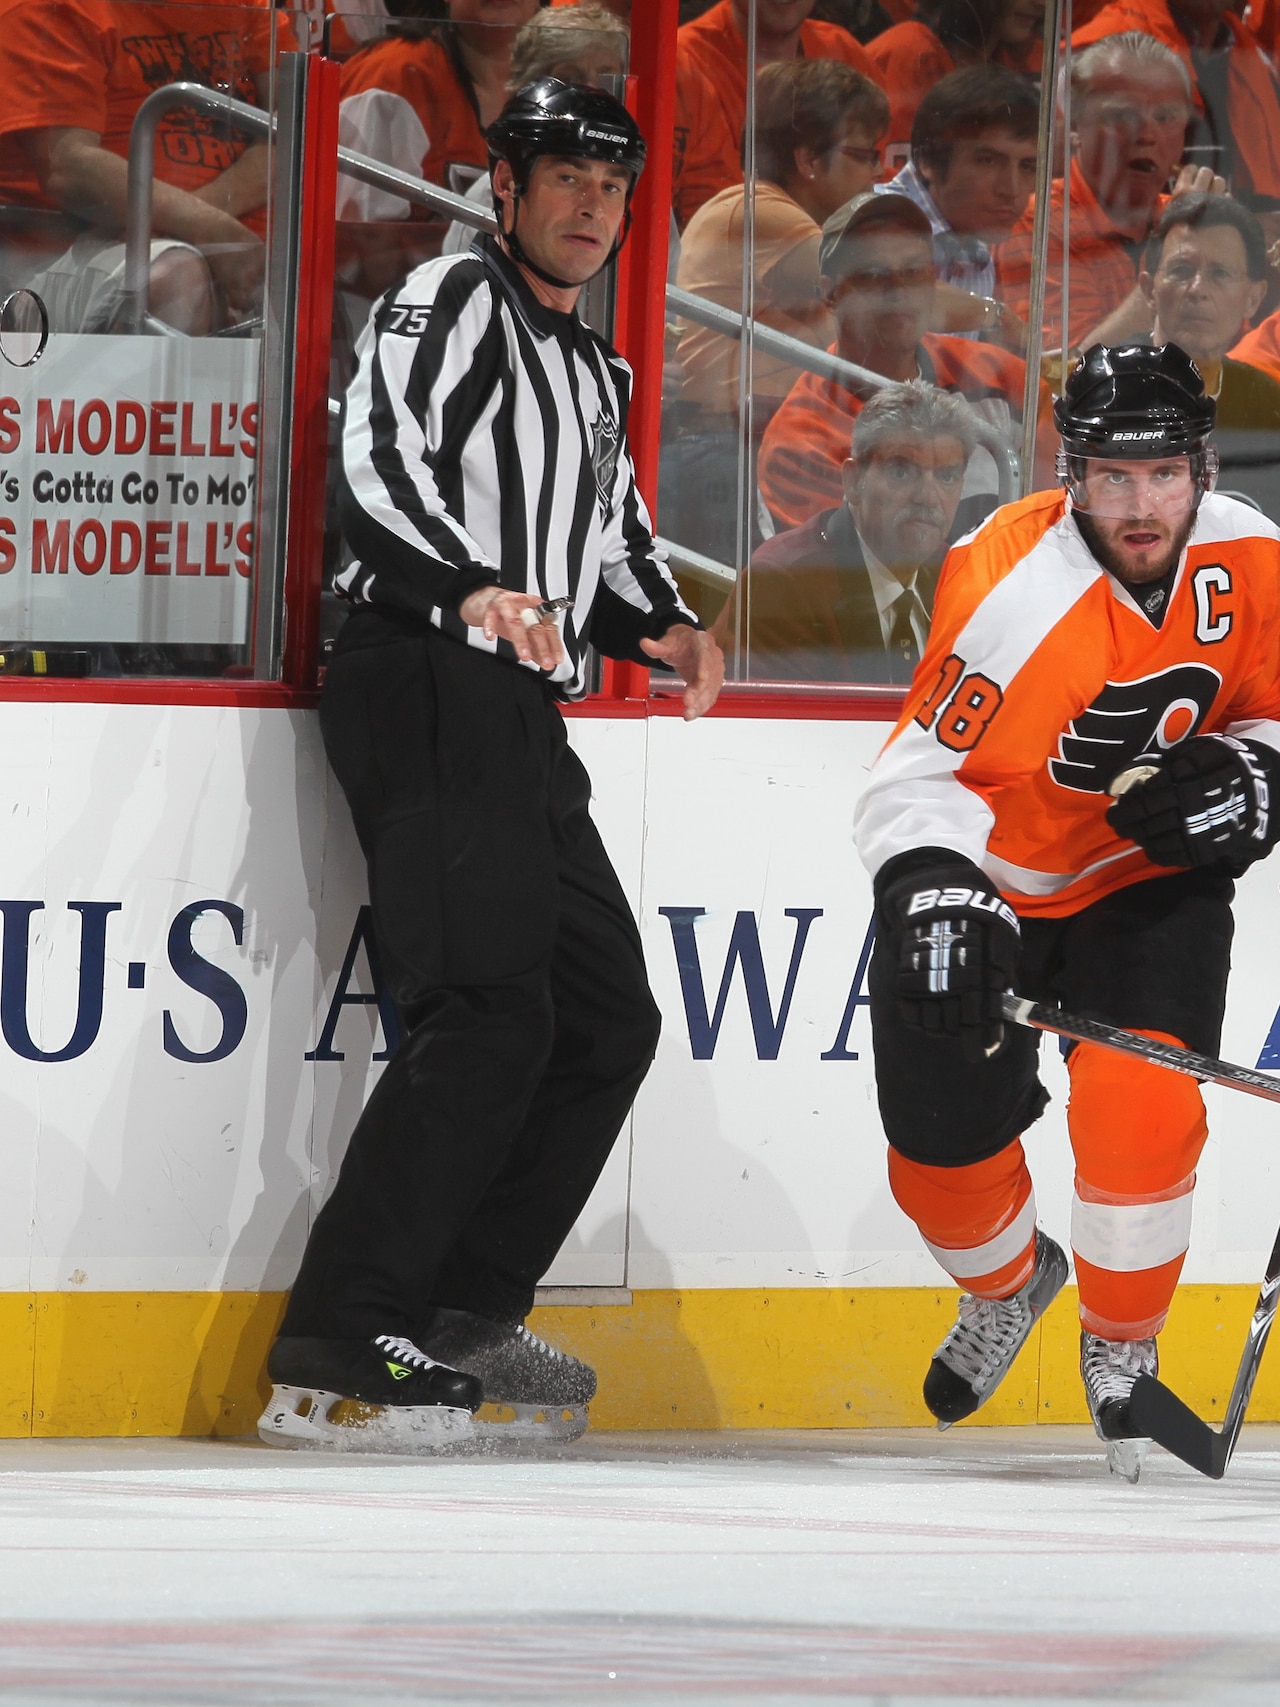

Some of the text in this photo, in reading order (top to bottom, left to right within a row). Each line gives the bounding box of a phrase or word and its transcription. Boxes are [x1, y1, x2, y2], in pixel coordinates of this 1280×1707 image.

[586, 129, 629, 146] BAUER
[387, 306, 429, 334] 75
[1112, 429, 1165, 442] BAUER
[32, 469, 113, 504] Gotta
[121, 471, 159, 505] Go
[166, 473, 199, 506] To
[206, 473, 256, 507] Mo'
[1192, 563, 1233, 644] C
[914, 653, 1004, 753] 18
[1212, 734, 1270, 841] AUER
[907, 887, 1021, 937] BAUE
